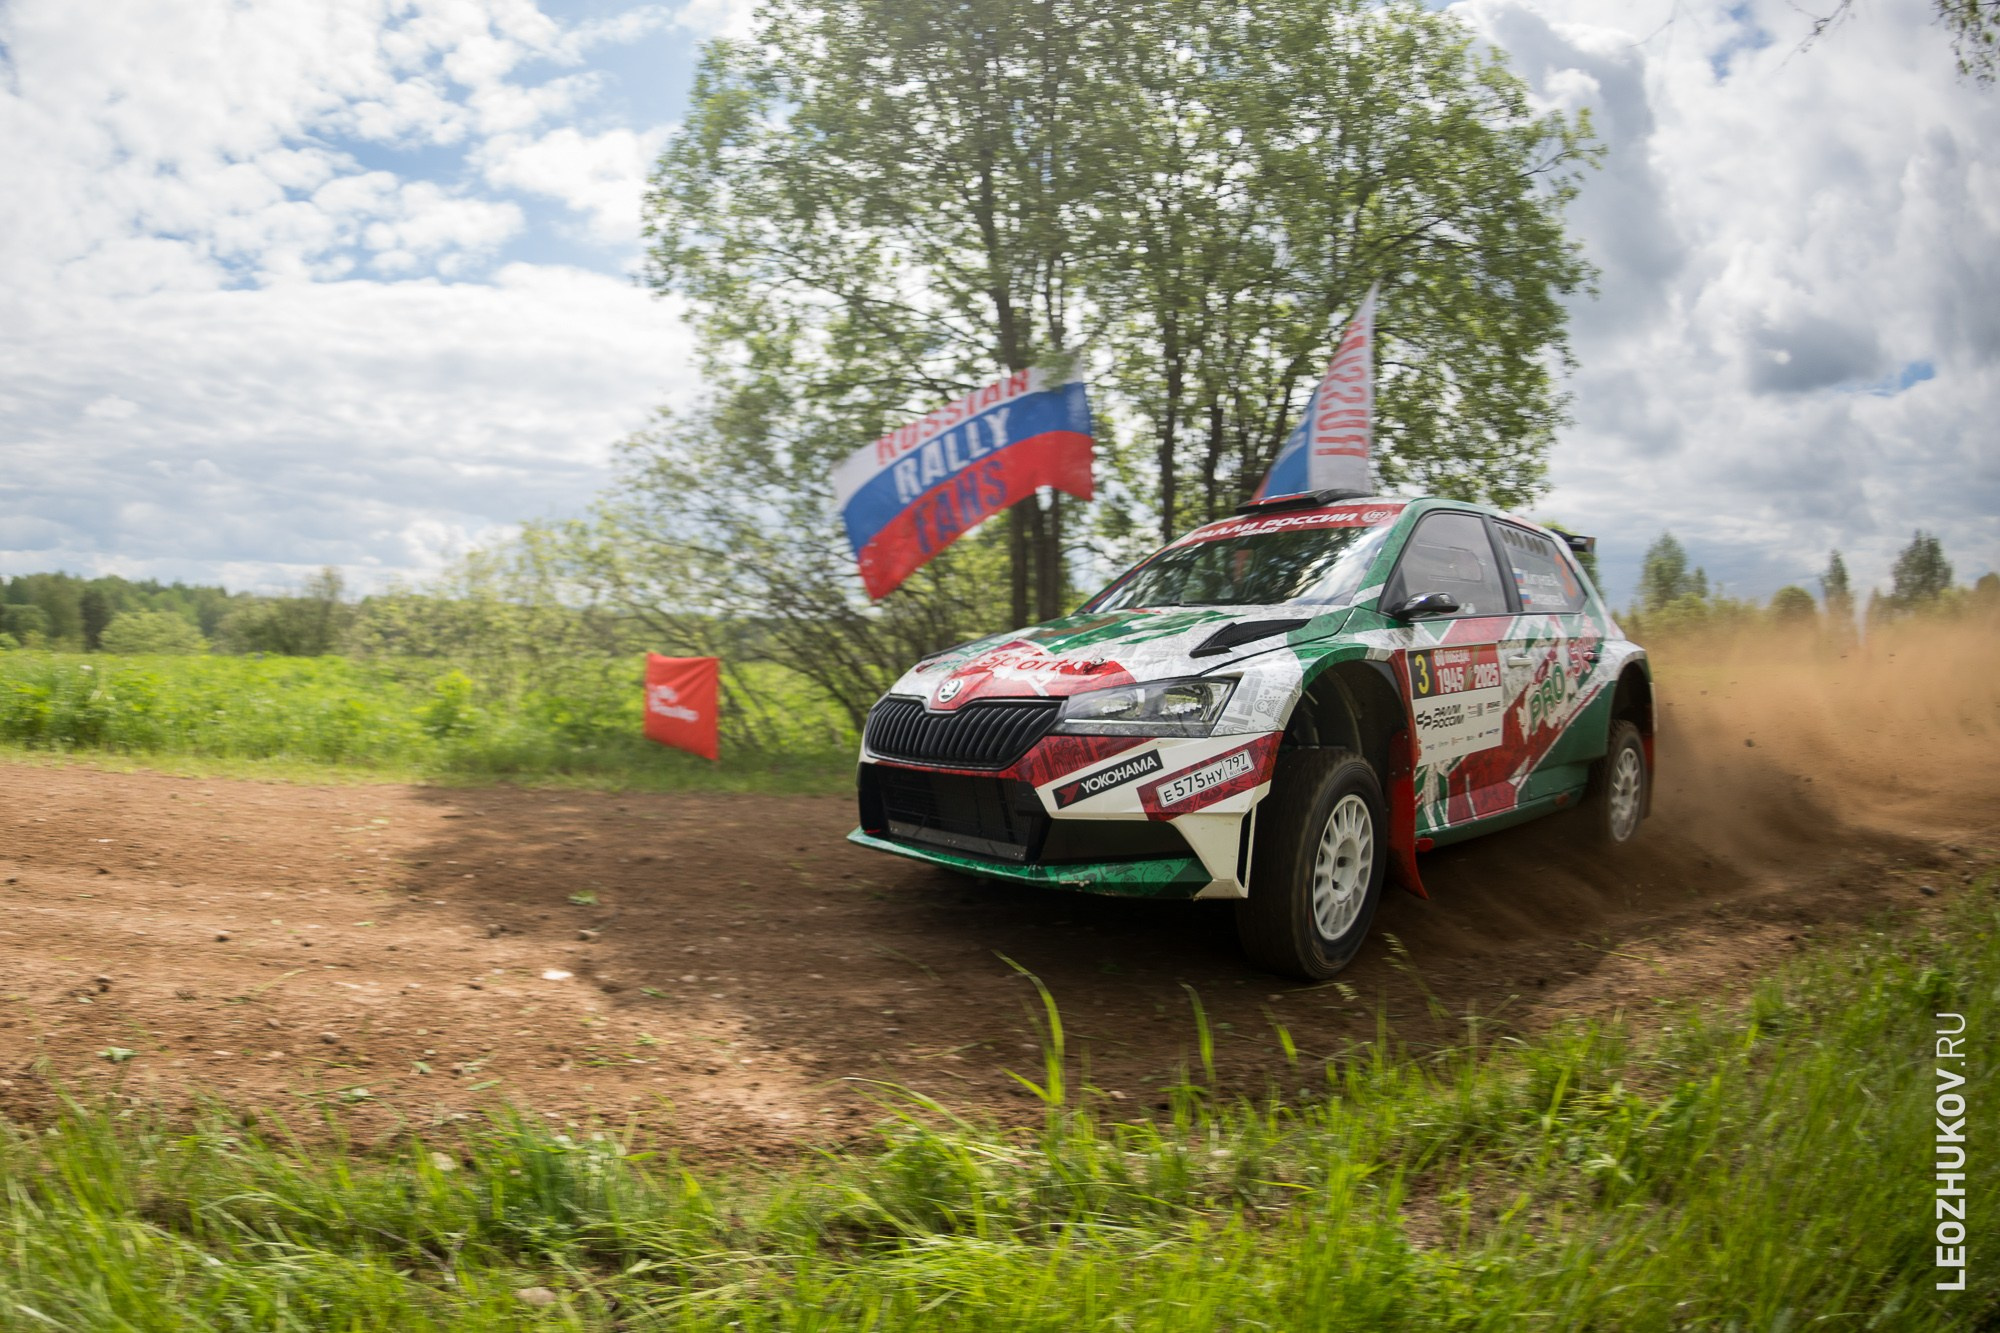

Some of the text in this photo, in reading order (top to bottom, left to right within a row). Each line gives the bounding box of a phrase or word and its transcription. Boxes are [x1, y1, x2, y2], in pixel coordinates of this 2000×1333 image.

[876, 368, 1030, 466] RUSSIAN
[893, 407, 1010, 504] RALLY
[913, 460, 1008, 555] FANS
[1259, 512, 1358, 528] РОССИИ
[1415, 654, 1430, 694] 3
[1437, 662, 1499, 694] 1945 2025
[1081, 756, 1158, 794] YOKOHAMA
[1225, 753, 1246, 771] 797
